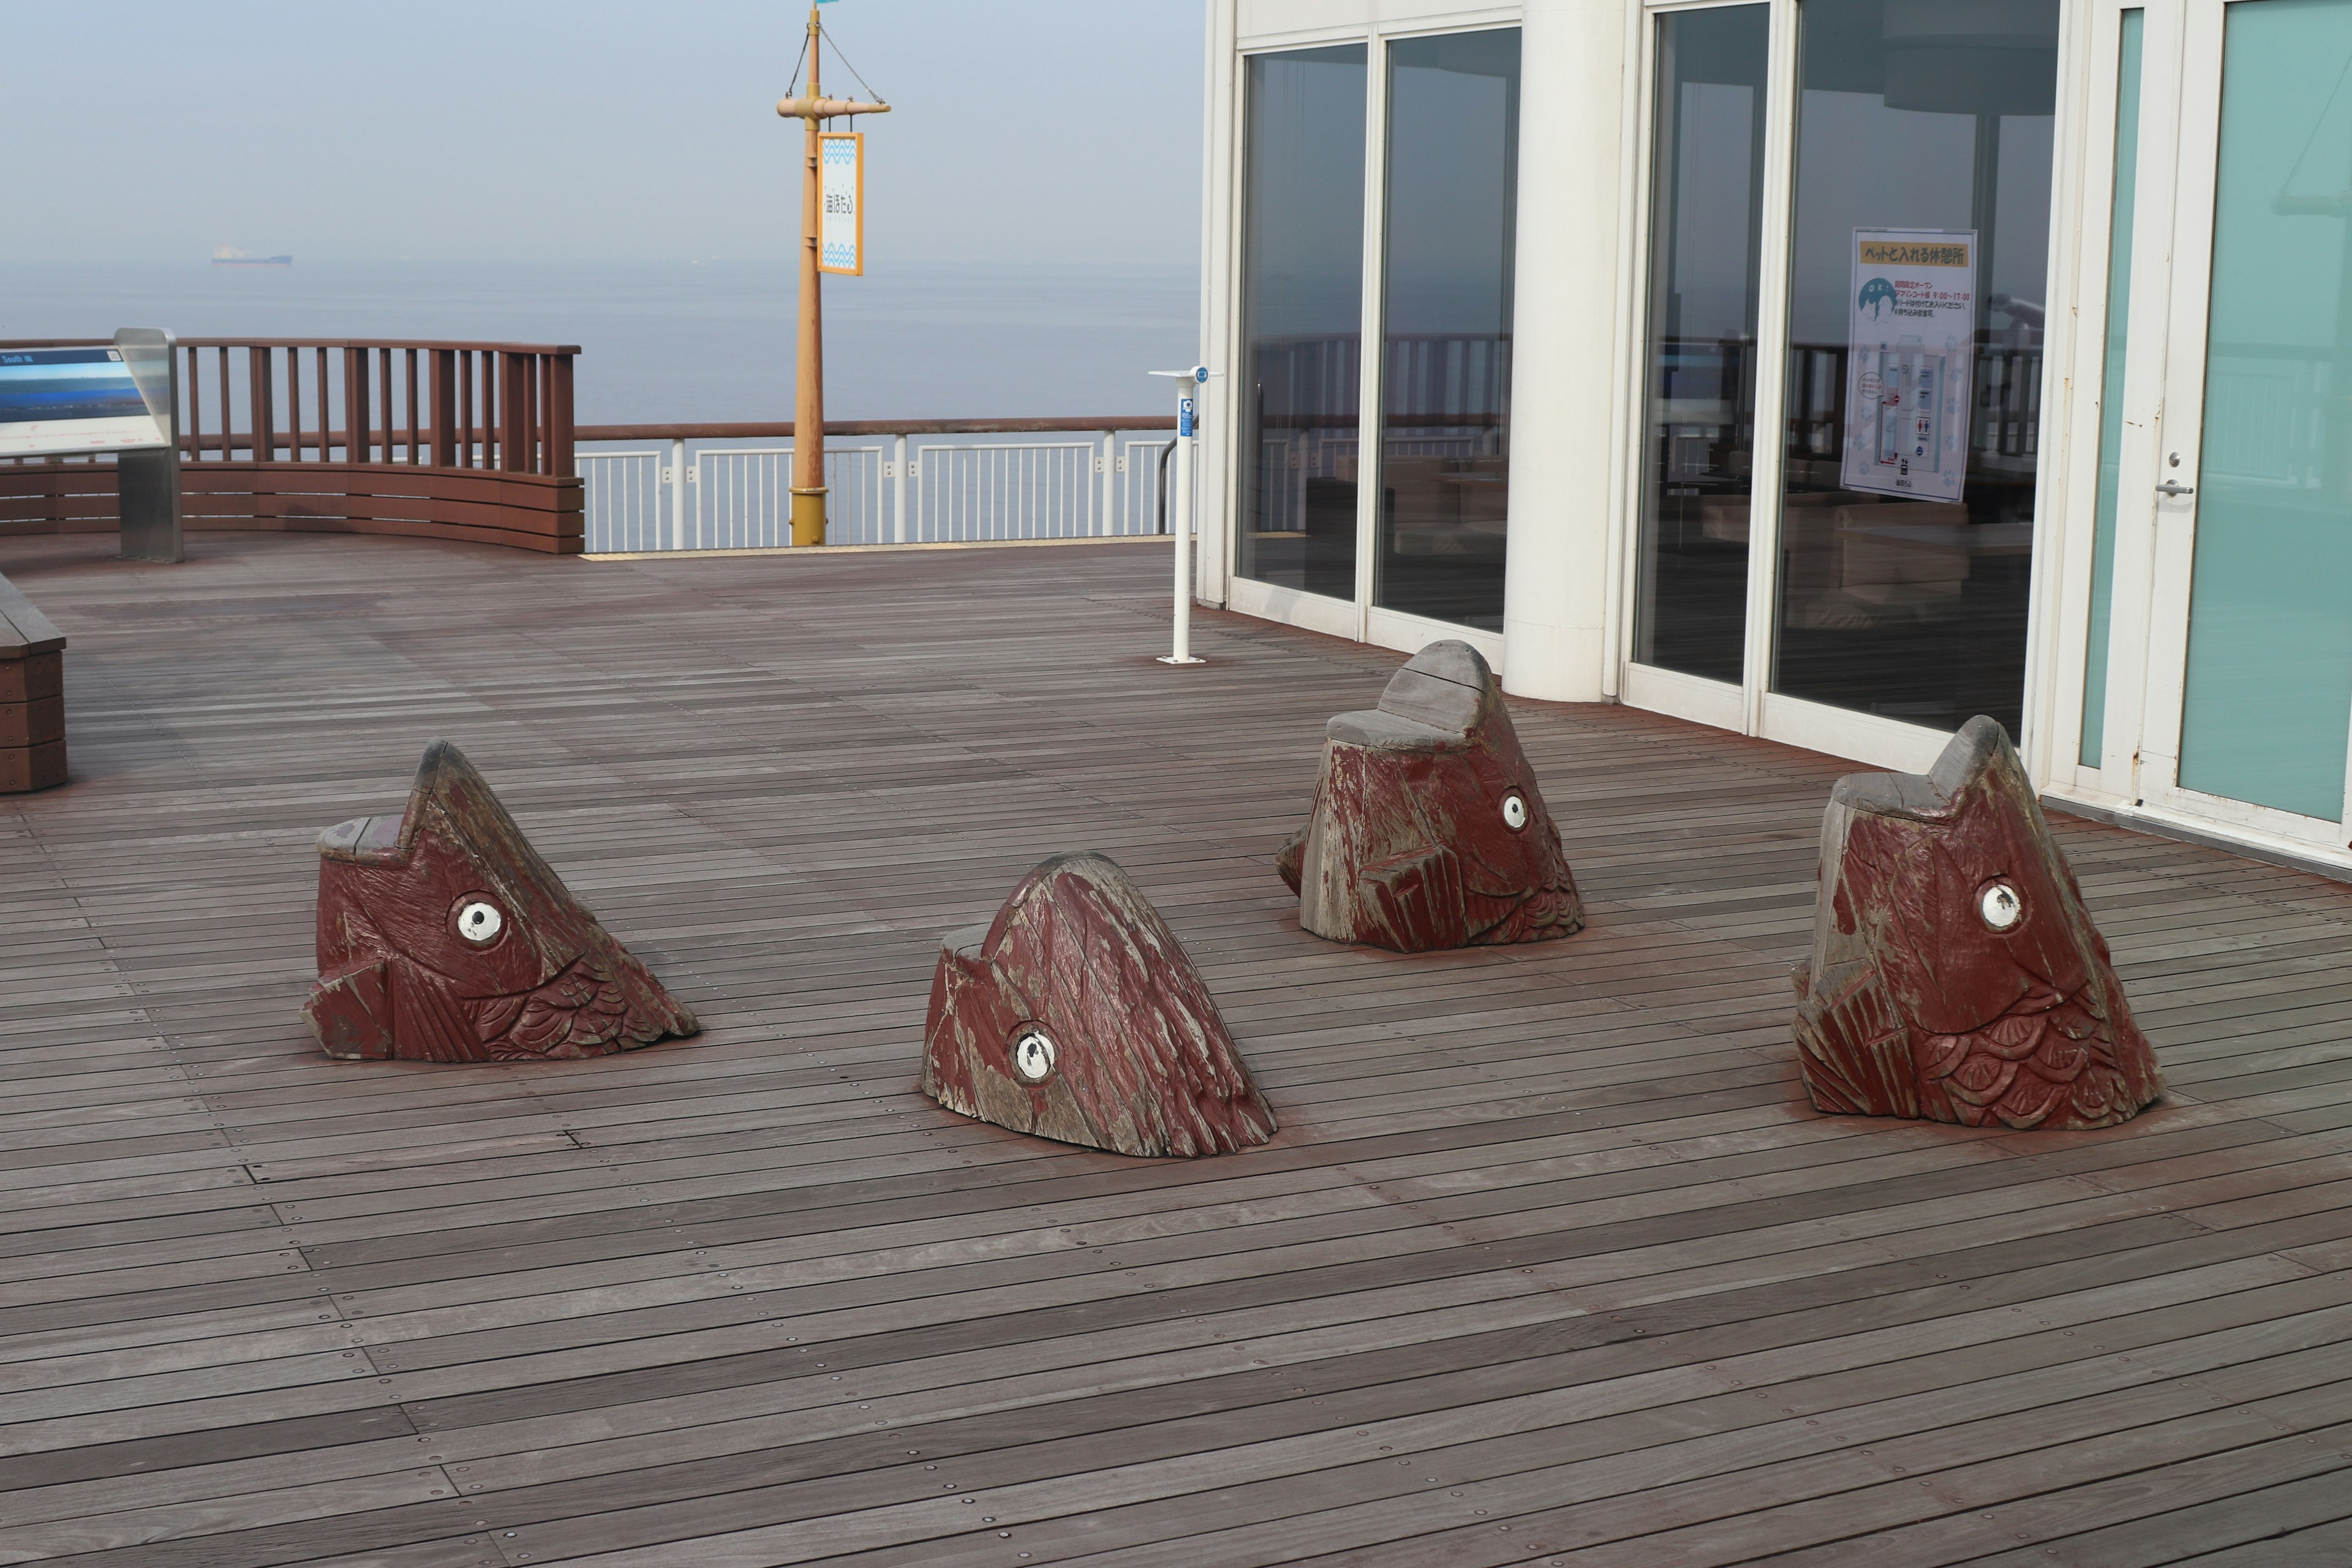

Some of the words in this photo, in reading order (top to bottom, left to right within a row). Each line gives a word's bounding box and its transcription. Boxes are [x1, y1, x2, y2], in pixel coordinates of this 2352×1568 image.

[826, 194, 853, 214] 海ほたる
[1865, 246, 1964, 265] ペットと入れる休憩所
[1896, 299, 1966, 310] リードは付けてお入りください。
